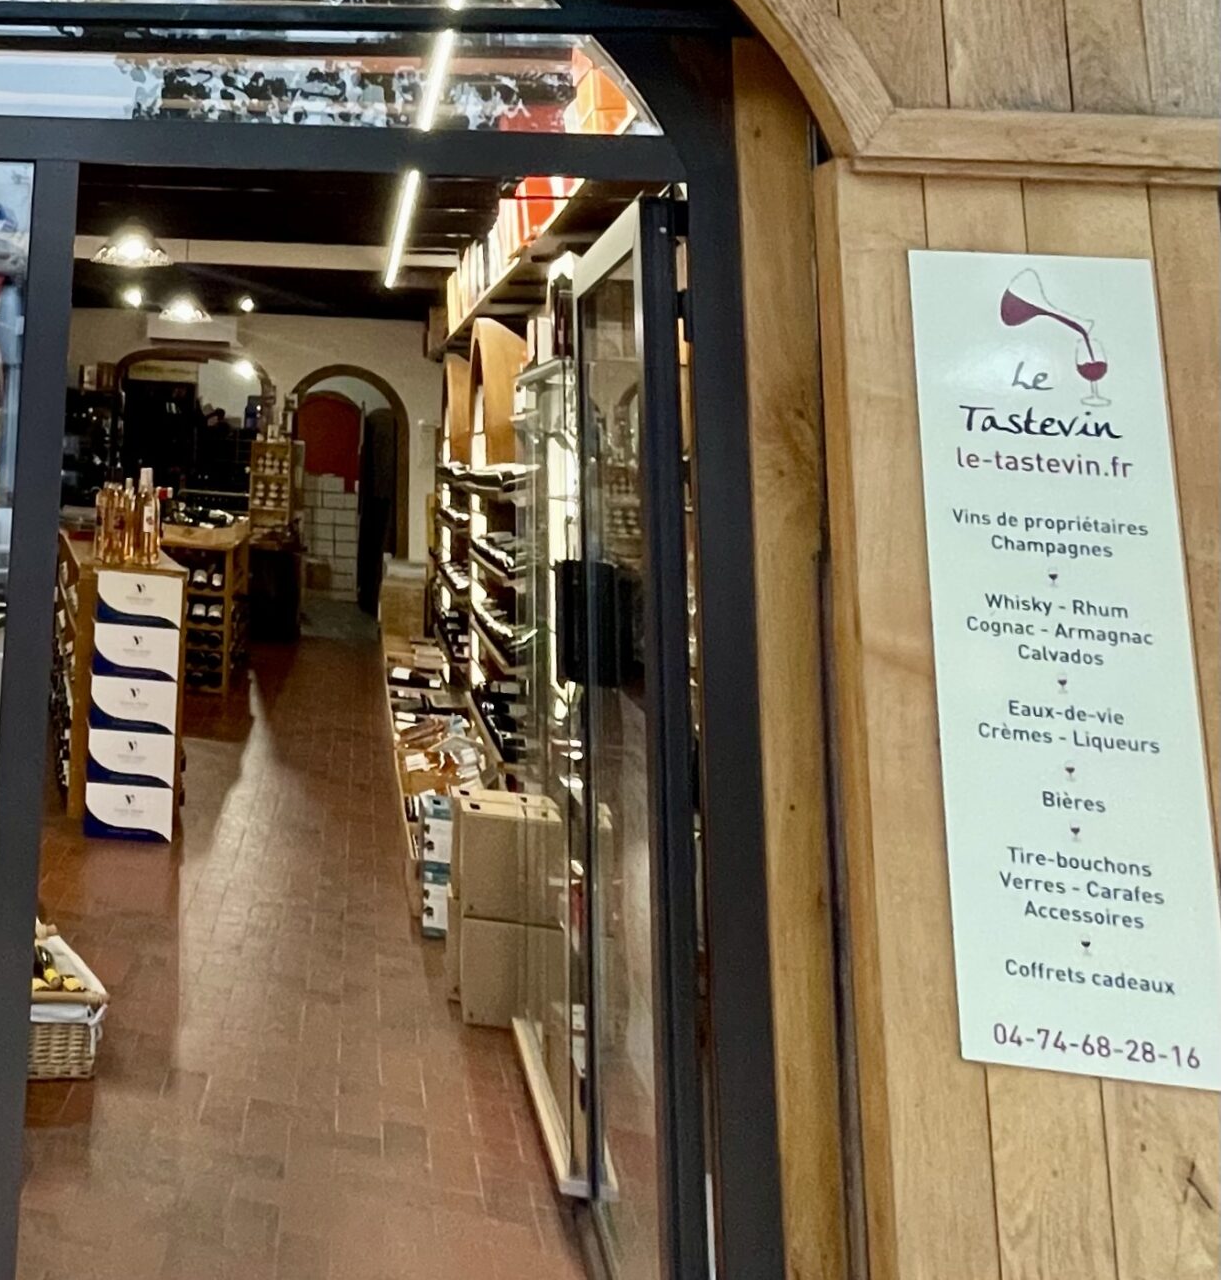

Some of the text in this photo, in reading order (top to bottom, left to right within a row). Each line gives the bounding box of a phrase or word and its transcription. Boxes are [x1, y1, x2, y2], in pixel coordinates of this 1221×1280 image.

[1012, 361, 1054, 391] Le
[959, 405, 1122, 439] Tastevin
[957, 447, 1133, 478] le-tastevin.fr
[952, 508, 1149, 537] Vins de propriétaires
[991, 535, 1114, 559] Champagnes
[985, 592, 1053, 616] Whisky
[1072, 599, 1129, 619] Rhum
[966, 616, 1035, 638] Cognac
[1054, 623, 1153, 646] Armagnac
[1017, 644, 1104, 666] Calvados
[1008, 700, 1125, 725] Eaux-de-vie
[978, 722, 1053, 745] Crèmes
[1072, 730, 1160, 754] Liqueurs
[1042, 791, 1106, 813] Bières
[1007, 846, 1152, 877] Tire-bouchons
[999, 871, 1066, 894] Verres
[1086, 881, 1165, 905] Carafes
[1024, 901, 1145, 929] Accessoires
[1005, 959, 1176, 995] Coffrets cadeaux
[993, 1023, 1201, 1070] 04-74-68-28-16
